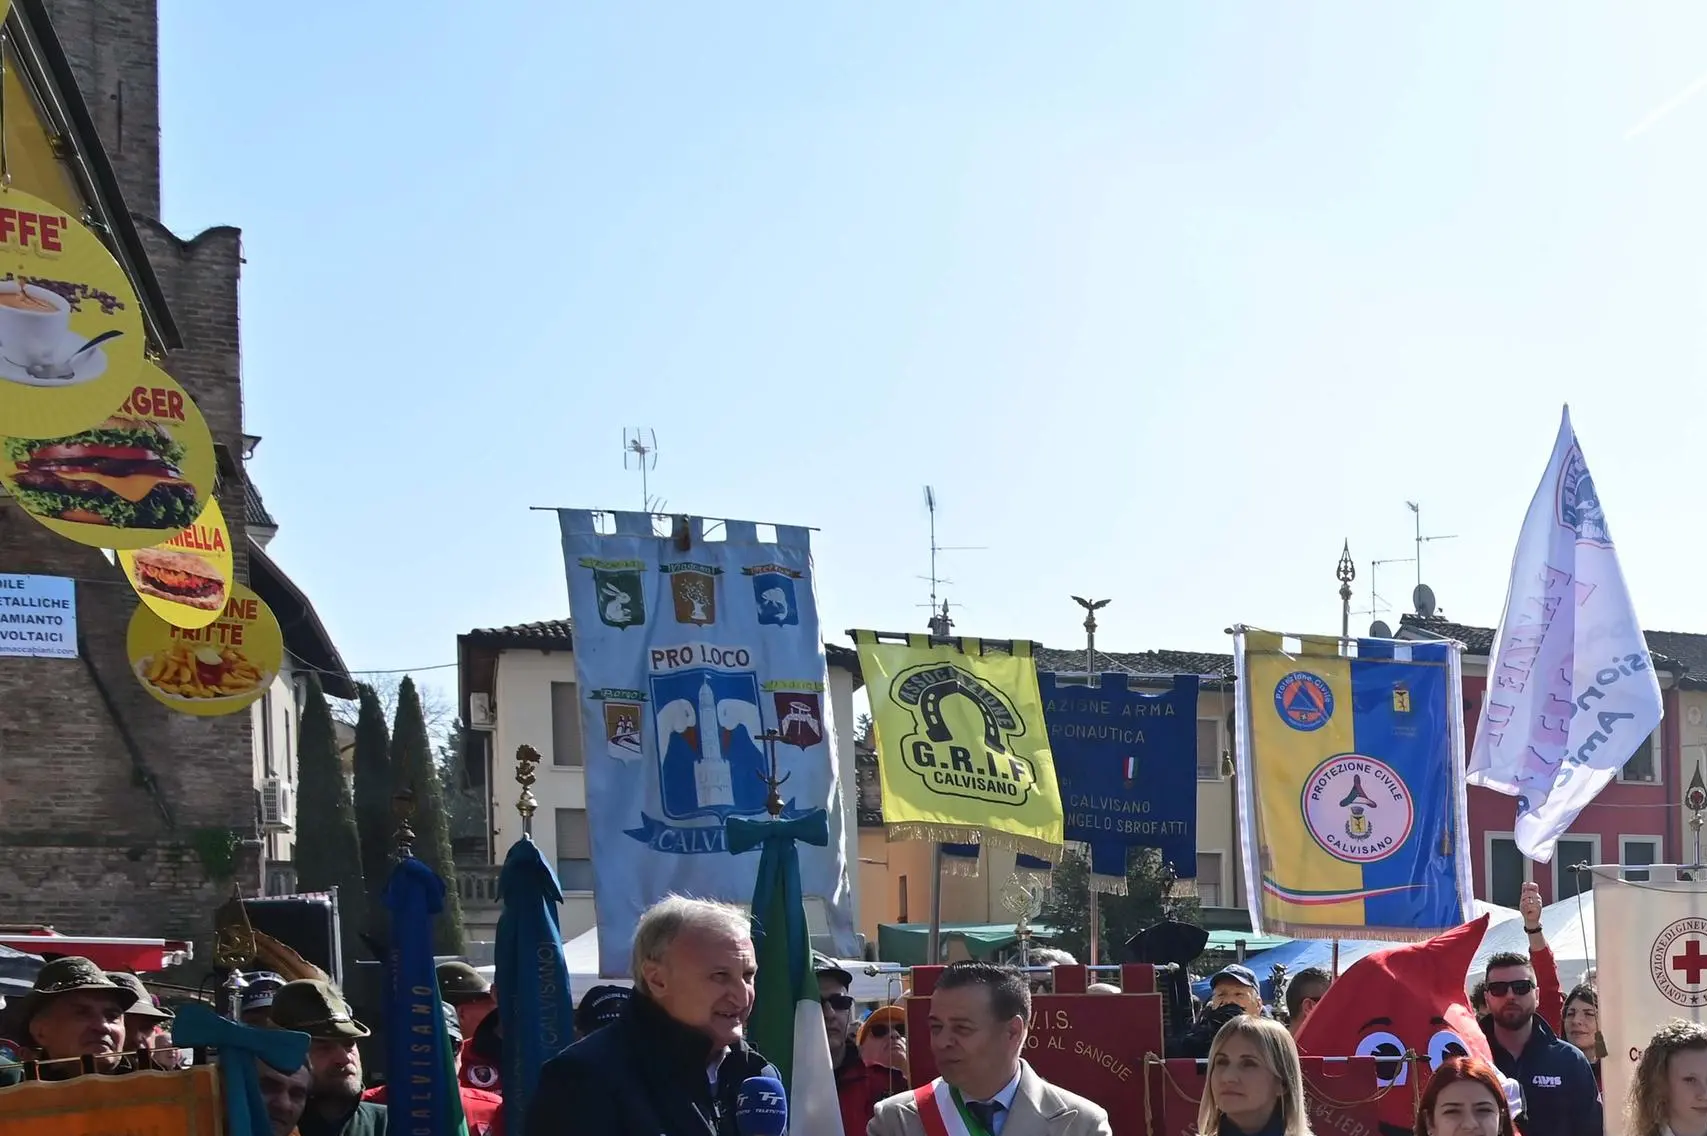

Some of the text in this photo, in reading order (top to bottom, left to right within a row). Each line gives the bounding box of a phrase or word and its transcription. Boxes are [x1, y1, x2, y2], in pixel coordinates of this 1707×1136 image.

[0, 579, 25, 589] ILE
[652, 644, 750, 670] PRO LOCO
[898, 665, 1016, 730] ASSOCIAZIONE
[1121, 702, 1176, 717] ARMA
[933, 771, 1018, 797] CALVISANO
[1311, 761, 1404, 801] PROTEZIONE CIVILE
[1069, 793, 1151, 814] CALVISANO
[1116, 816, 1188, 837] SBROFATTI
[1325, 833, 1394, 855] CALVISANO
[1663, 928, 1677, 942] DI
[1654, 938, 1688, 1004] CONVENZIONE
[1047, 1036, 1066, 1050] AL
[1074, 1040, 1132, 1082] SANGUE
